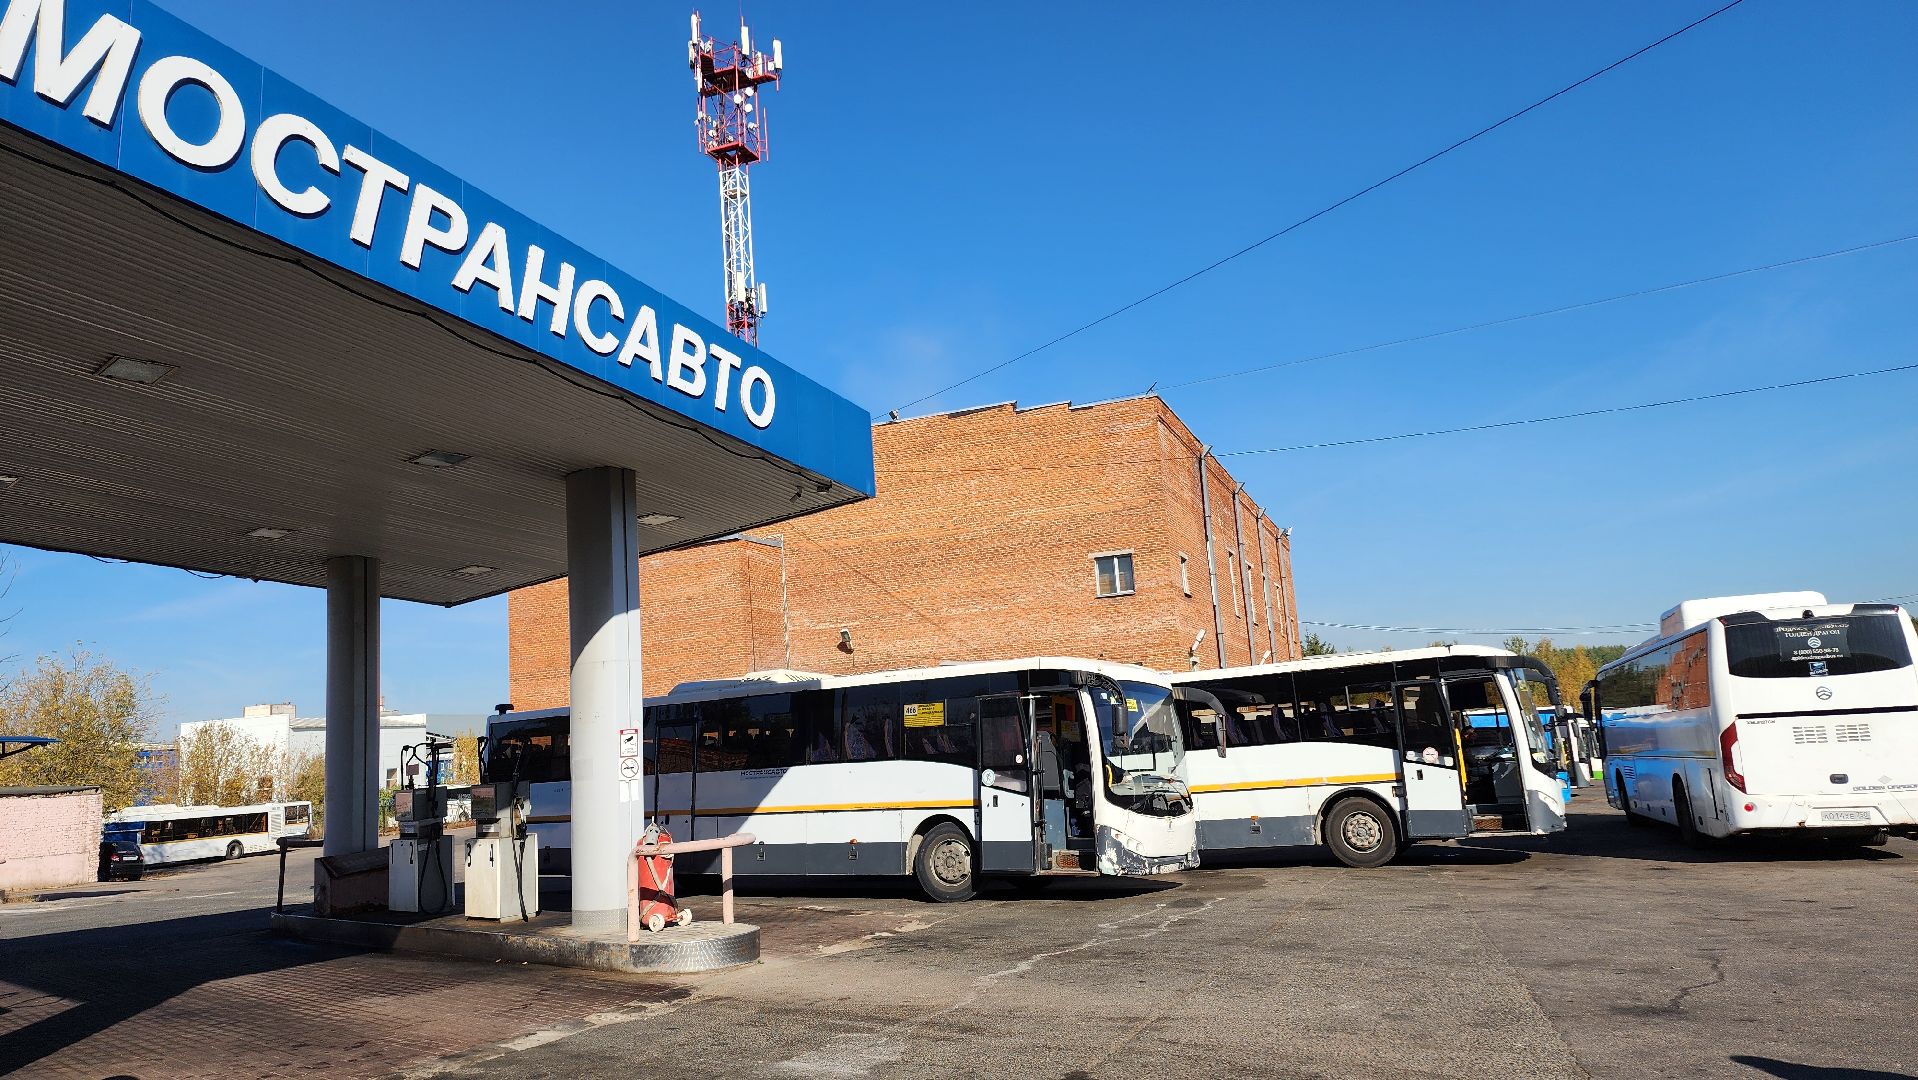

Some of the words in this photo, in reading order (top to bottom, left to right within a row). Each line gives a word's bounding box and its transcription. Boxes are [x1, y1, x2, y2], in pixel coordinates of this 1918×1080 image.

[0, 0, 776, 429] МОСТРАНСАВТО
[409, 841, 414, 865] 2
[466, 842, 472, 868] 3
[489, 843, 494, 868] 4
